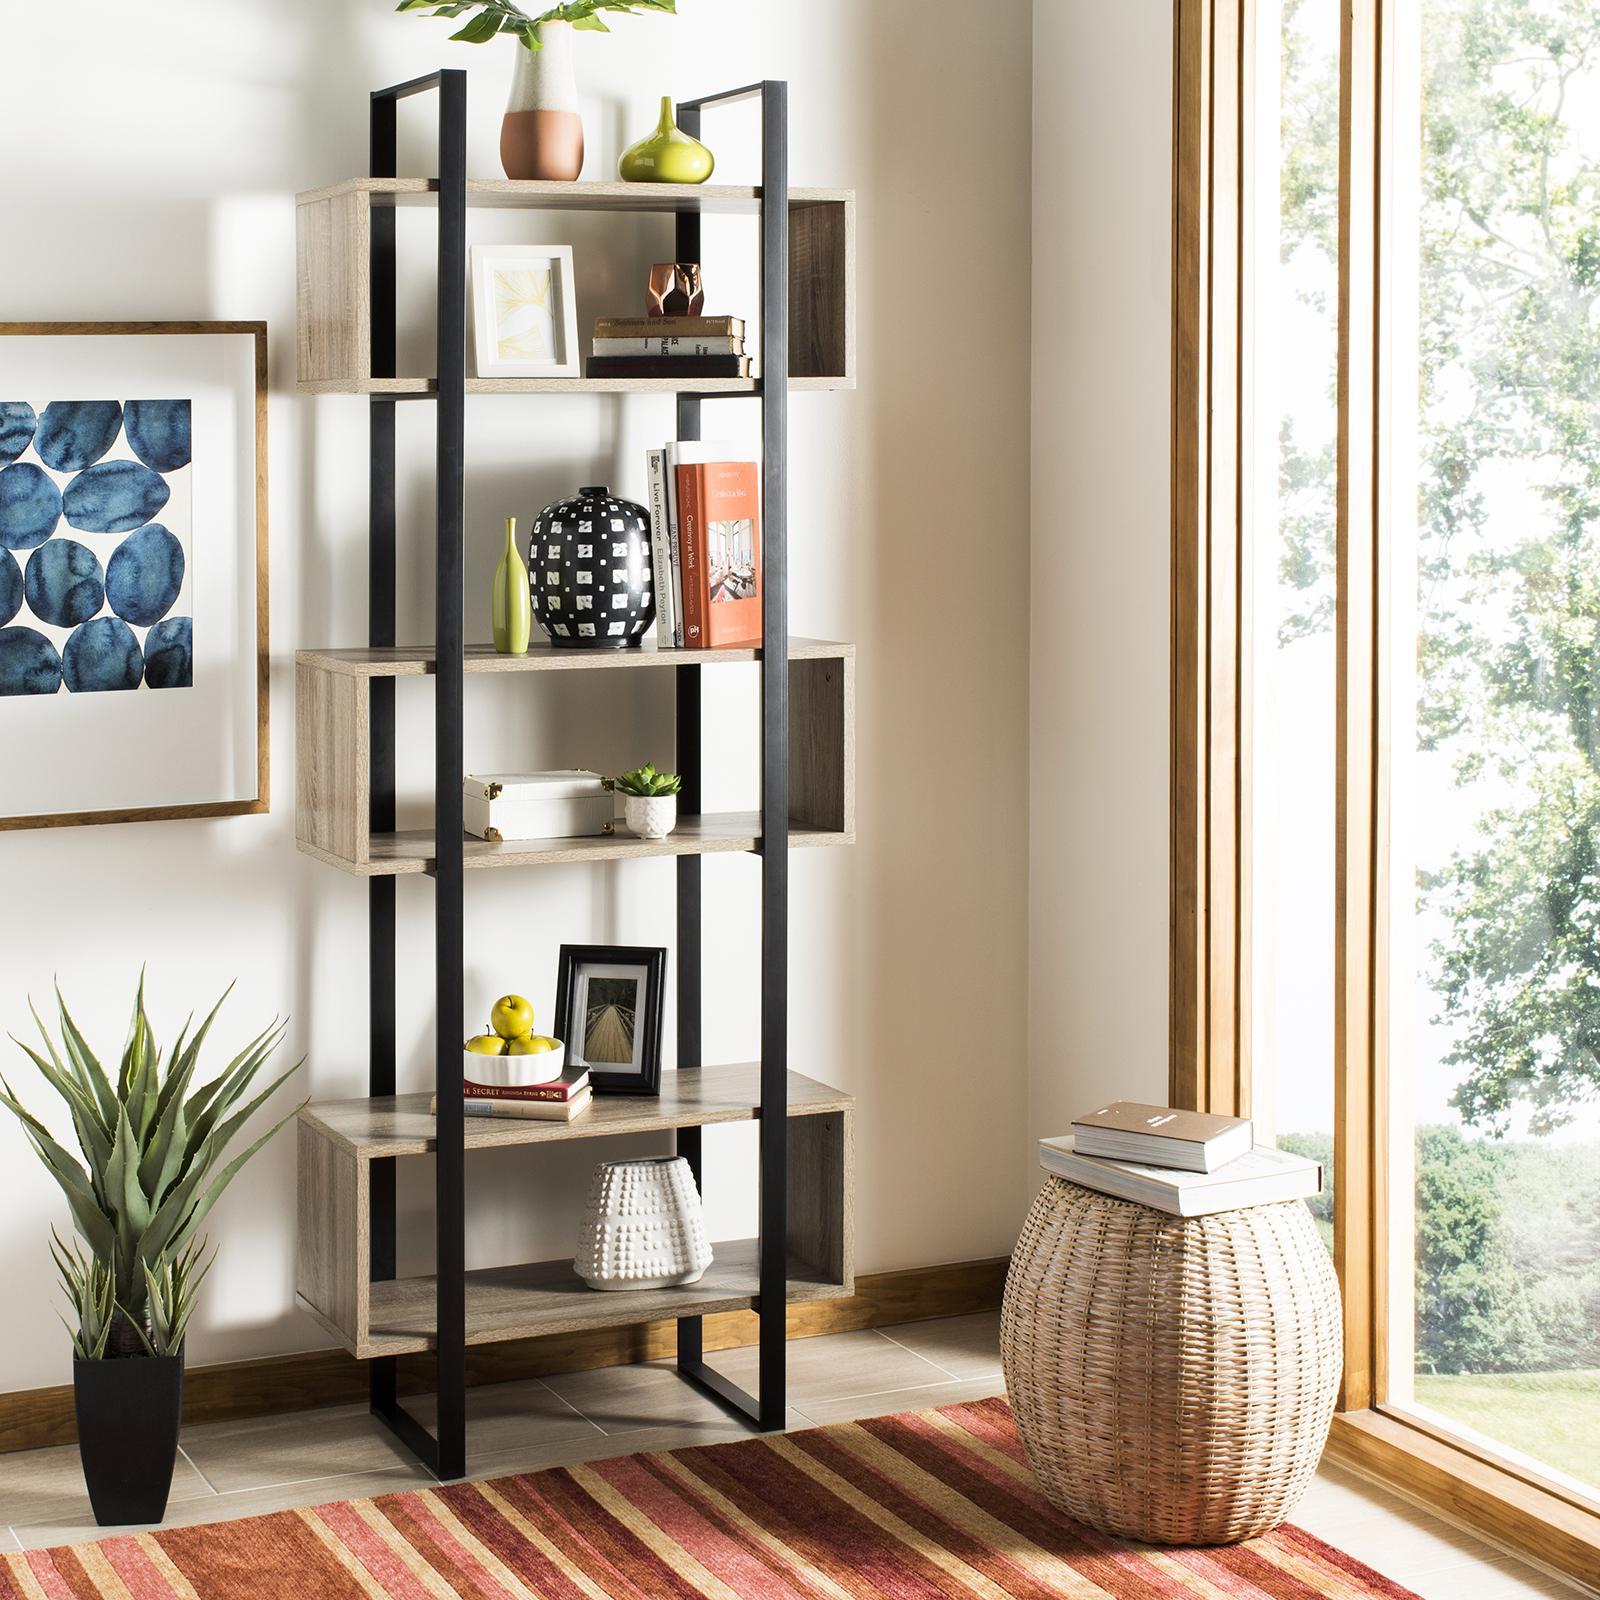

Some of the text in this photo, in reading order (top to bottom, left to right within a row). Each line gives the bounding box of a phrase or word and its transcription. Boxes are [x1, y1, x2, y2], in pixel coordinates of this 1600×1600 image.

[686, 514, 694, 544] Creativity
[657, 548, 665, 591] Elizabeth
[687, 552, 695, 569] Work
[659, 593, 667, 625] Peyton
[472, 1087, 500, 1097] SECRET
